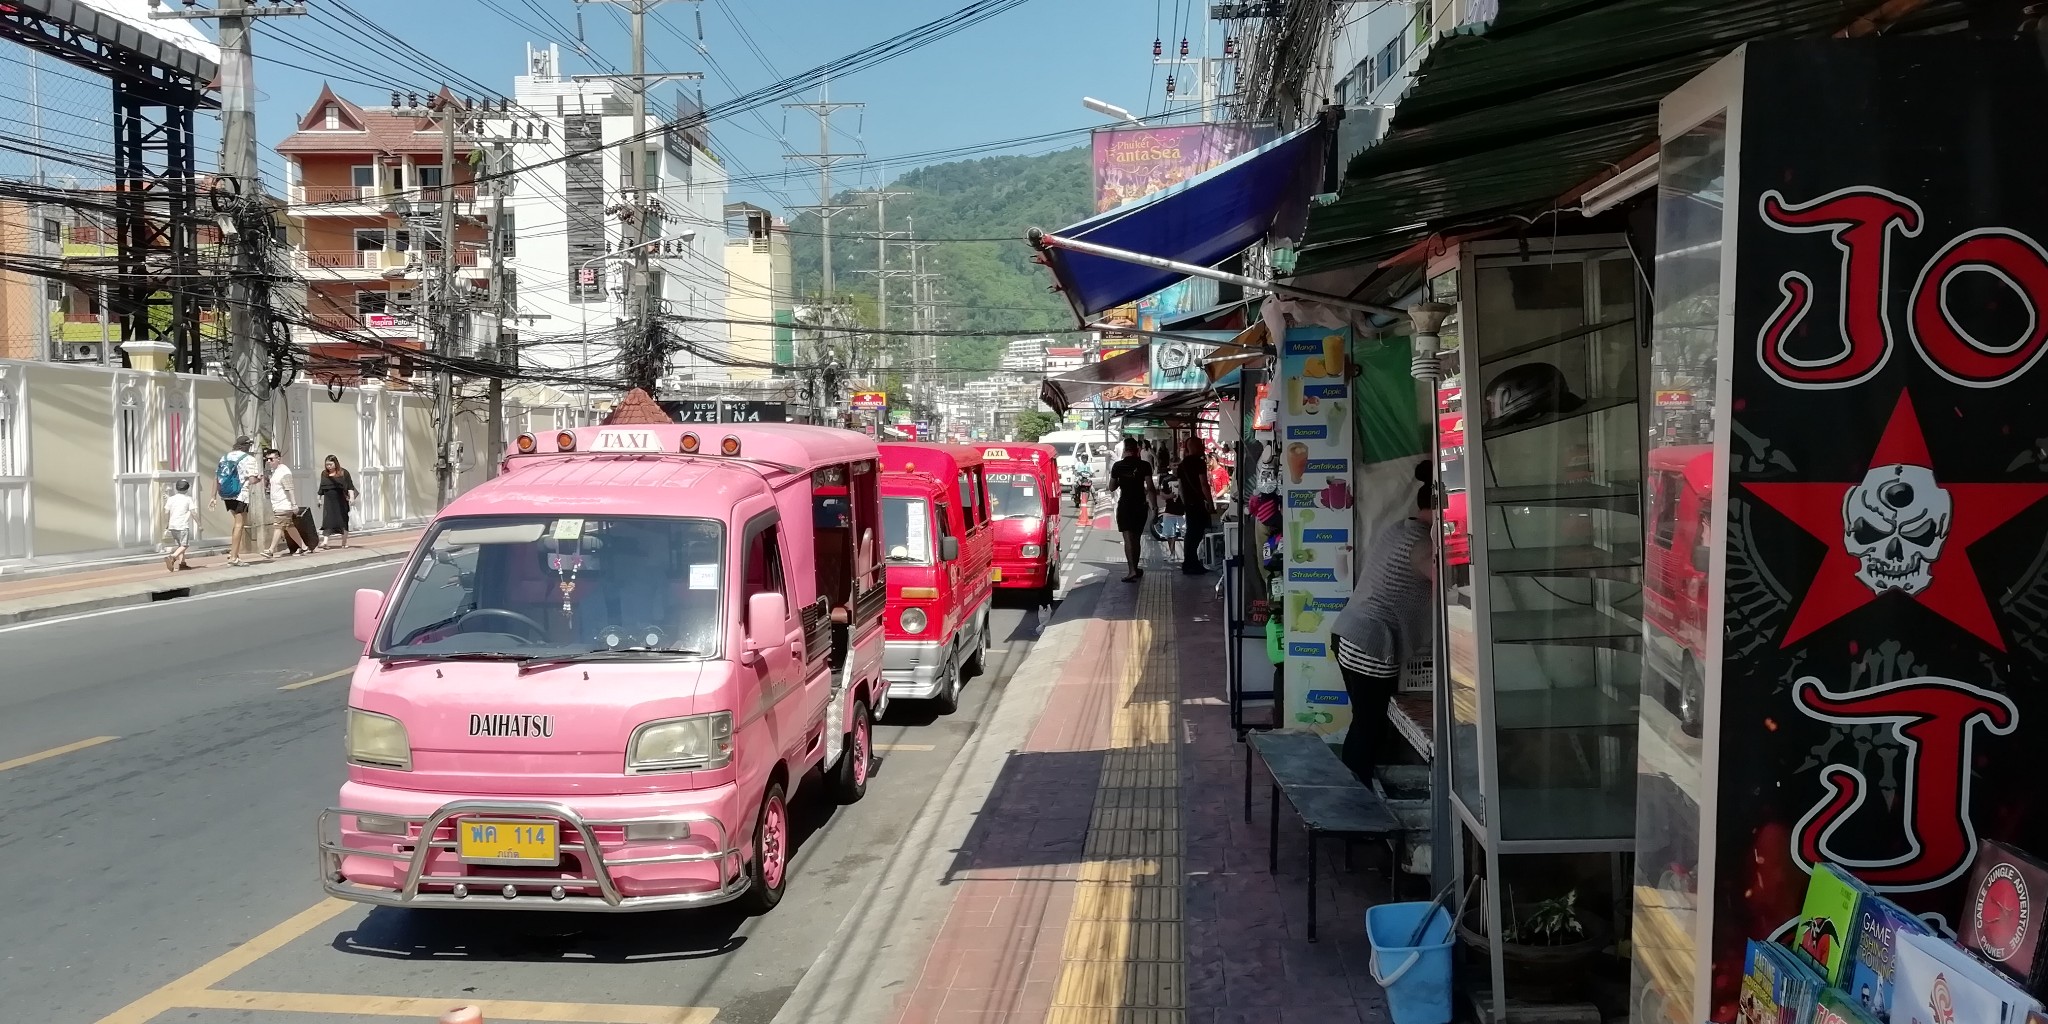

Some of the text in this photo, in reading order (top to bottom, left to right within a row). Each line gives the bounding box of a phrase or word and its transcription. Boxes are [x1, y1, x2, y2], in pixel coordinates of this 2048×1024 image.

[1117, 140, 1149, 150] Phuket
[1292, 344, 1317, 352] Mango
[1322, 388, 1341, 397] Apple
[679, 410, 760, 422] VIENA
[600, 433, 649, 449] TAXI
[1291, 570, 1333, 580] Strawberry
[1294, 645, 1320, 654] Orange
[1315, 693, 1340, 701] Lemon
[469, 713, 554, 738] DAIHATSU
[514, 826, 546, 845] 114
[1976, 867, 2027, 950] CABLE JUNGLE ADVENTURE
[1863, 912, 1892, 947] GAME
[1980, 935, 2006, 958] PHUKET
